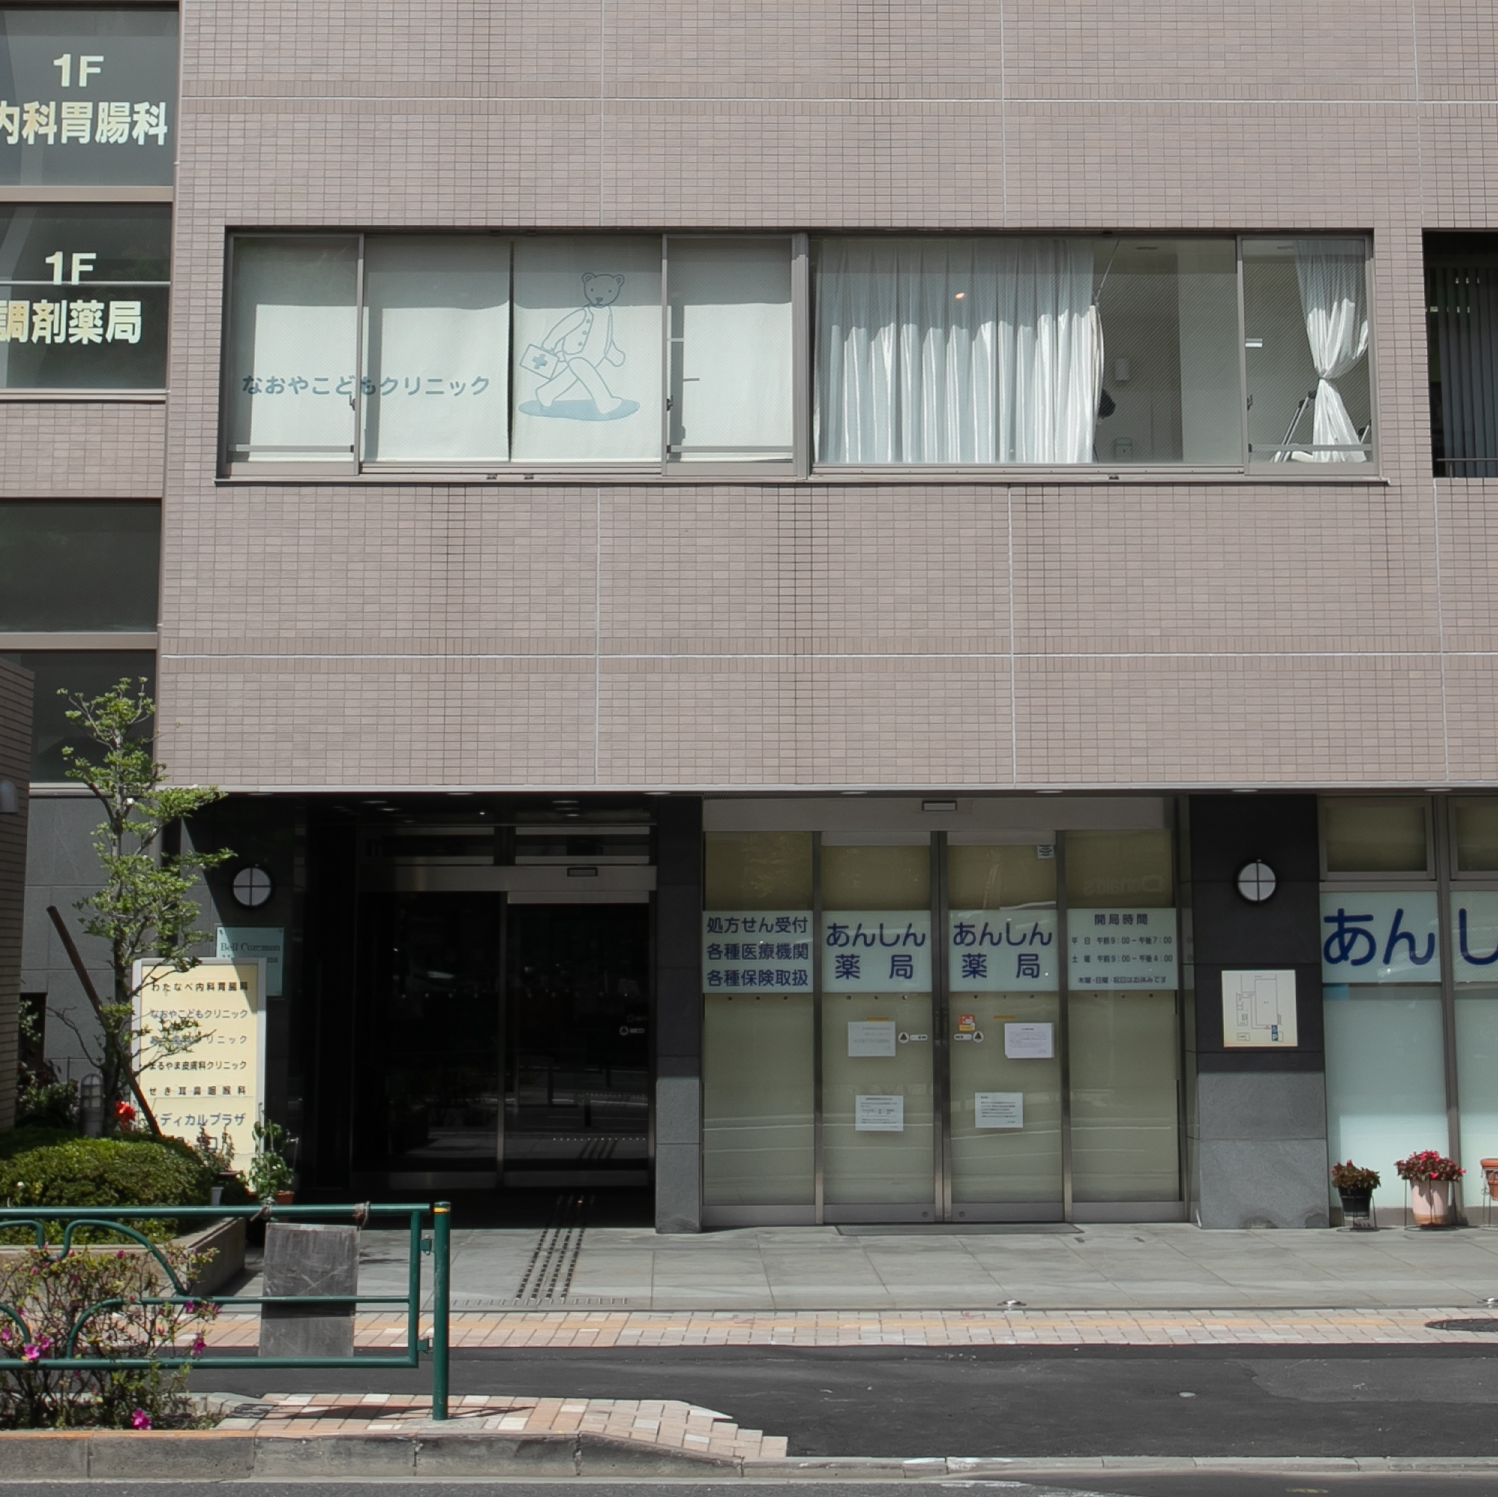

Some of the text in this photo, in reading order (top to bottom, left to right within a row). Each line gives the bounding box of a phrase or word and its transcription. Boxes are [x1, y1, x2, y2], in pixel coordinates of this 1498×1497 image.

[53, 54, 104, 87] 1F
[45, 251, 97, 286] 1F
[241, 375, 490, 397] なおやこどもクリニック
[707, 916, 808, 934] 処方せん受付
[1094, 914, 1148, 925] 開局時間
[826, 923, 926, 947] あんしん
[953, 922, 1052, 946] あんしん
[1071, 937, 1091, 945] 平日
[241, 943, 280, 952] Common
[707, 943, 808, 960] 各種医療機関
[835, 954, 914, 980] 薬局
[962, 953, 1040, 979] 薬局
[151, 981, 248, 992] わたなべ内科胃腸科
[707, 969, 808, 987] 各種保険取扱
[150, 1008, 248, 1019] なおやこどもクリニック
